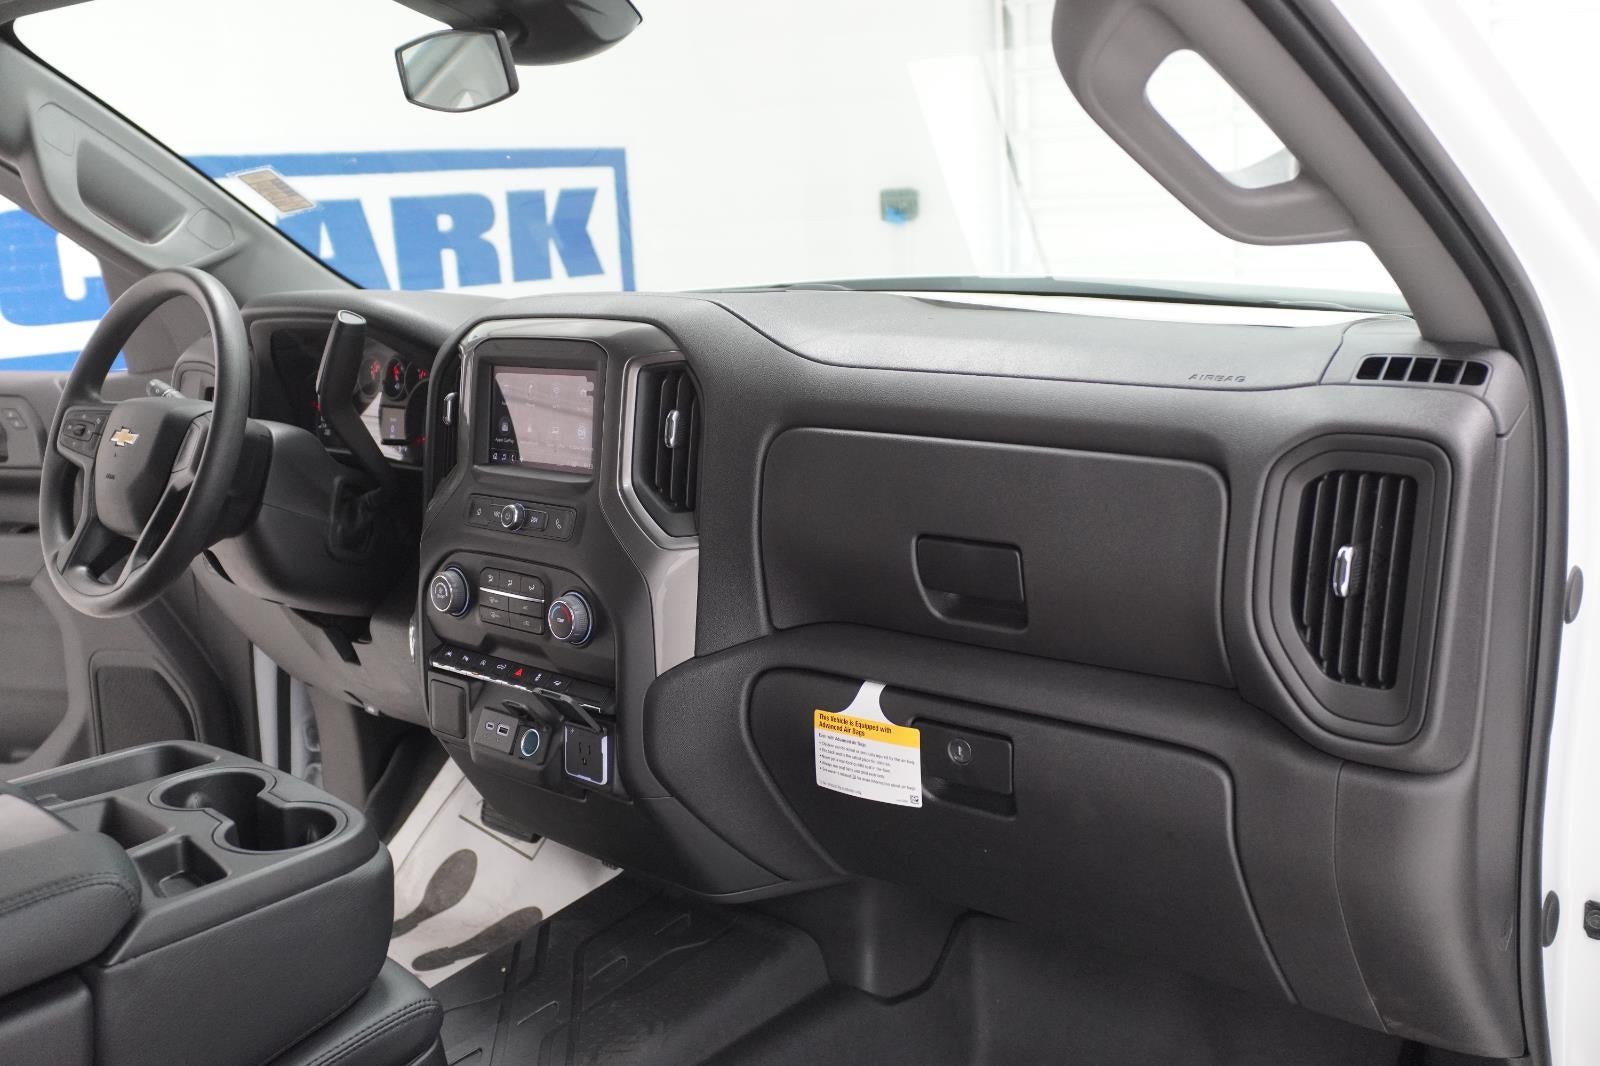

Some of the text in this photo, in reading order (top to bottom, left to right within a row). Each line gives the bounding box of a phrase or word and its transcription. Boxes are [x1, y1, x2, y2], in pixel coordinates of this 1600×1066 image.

[1188, 374, 1246, 383] AIRBAG
[818, 721, 865, 737] Advanced Air Bags
[819, 713, 830, 721] This
[831, 715, 849, 725] Vehicle
[855, 720, 879, 732] Equipped
[880, 725, 892, 734] with
